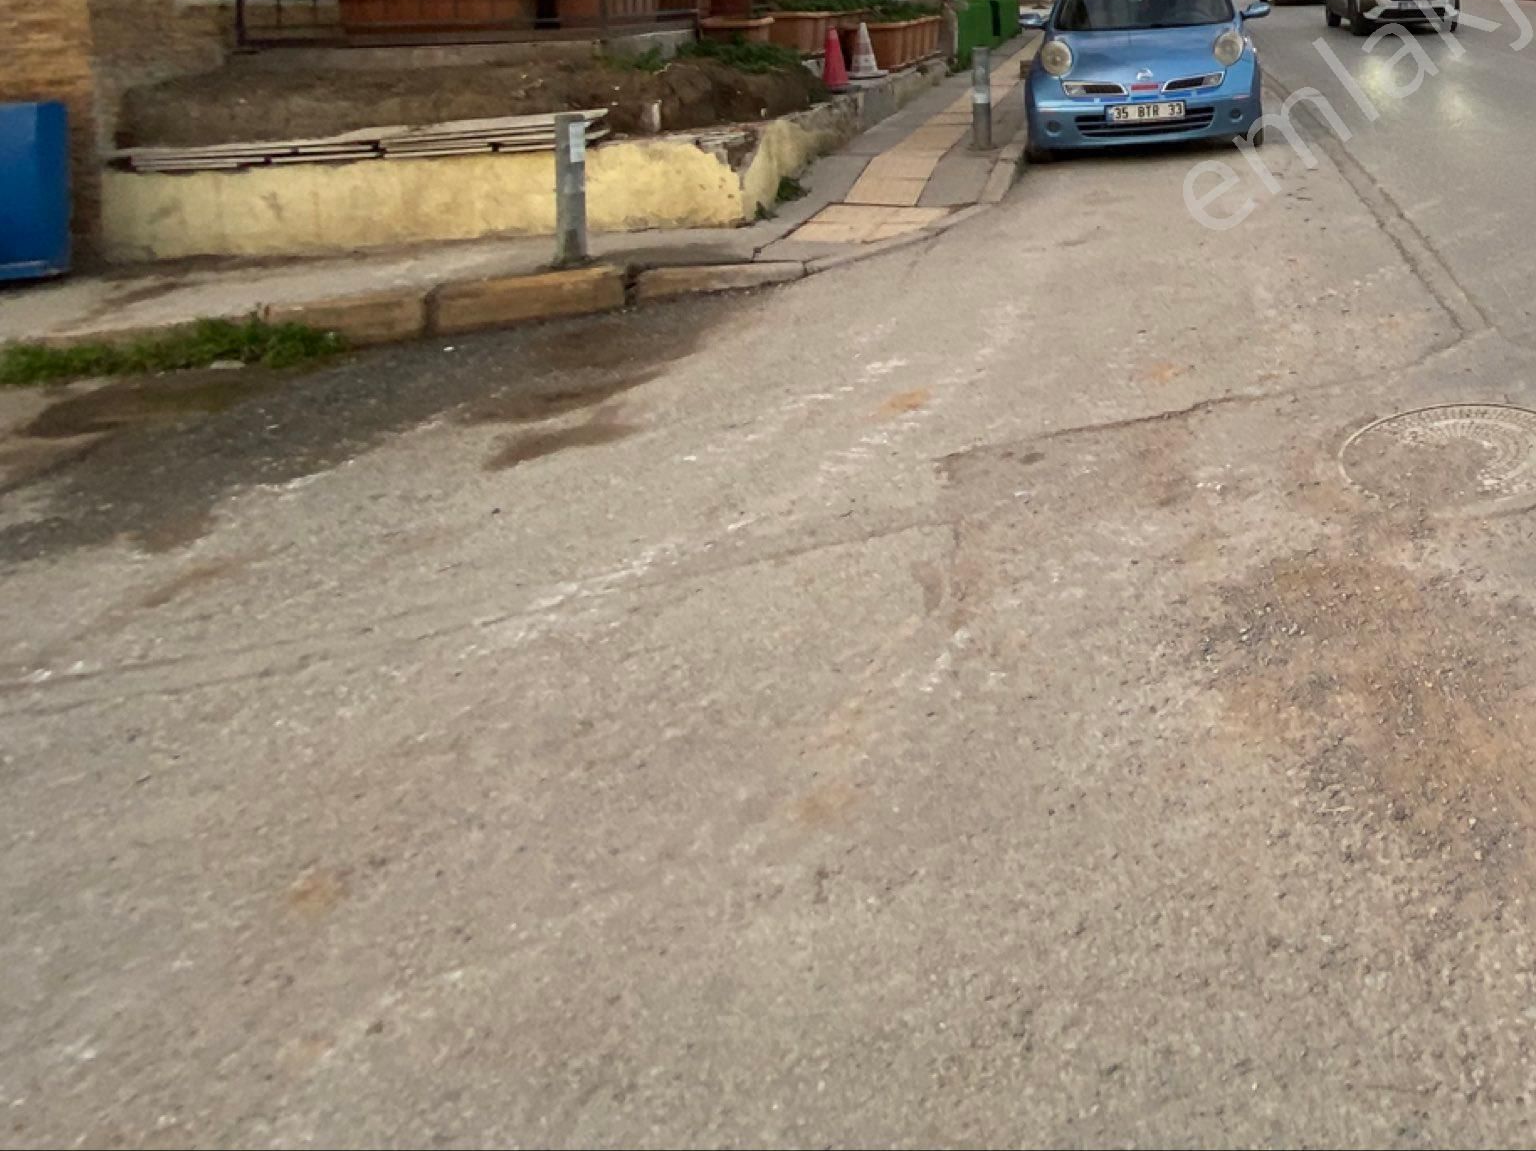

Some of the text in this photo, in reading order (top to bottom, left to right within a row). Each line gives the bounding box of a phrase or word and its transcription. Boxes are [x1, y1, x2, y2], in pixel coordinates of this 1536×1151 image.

[1114, 103, 1182, 120] 35 BTR 33
